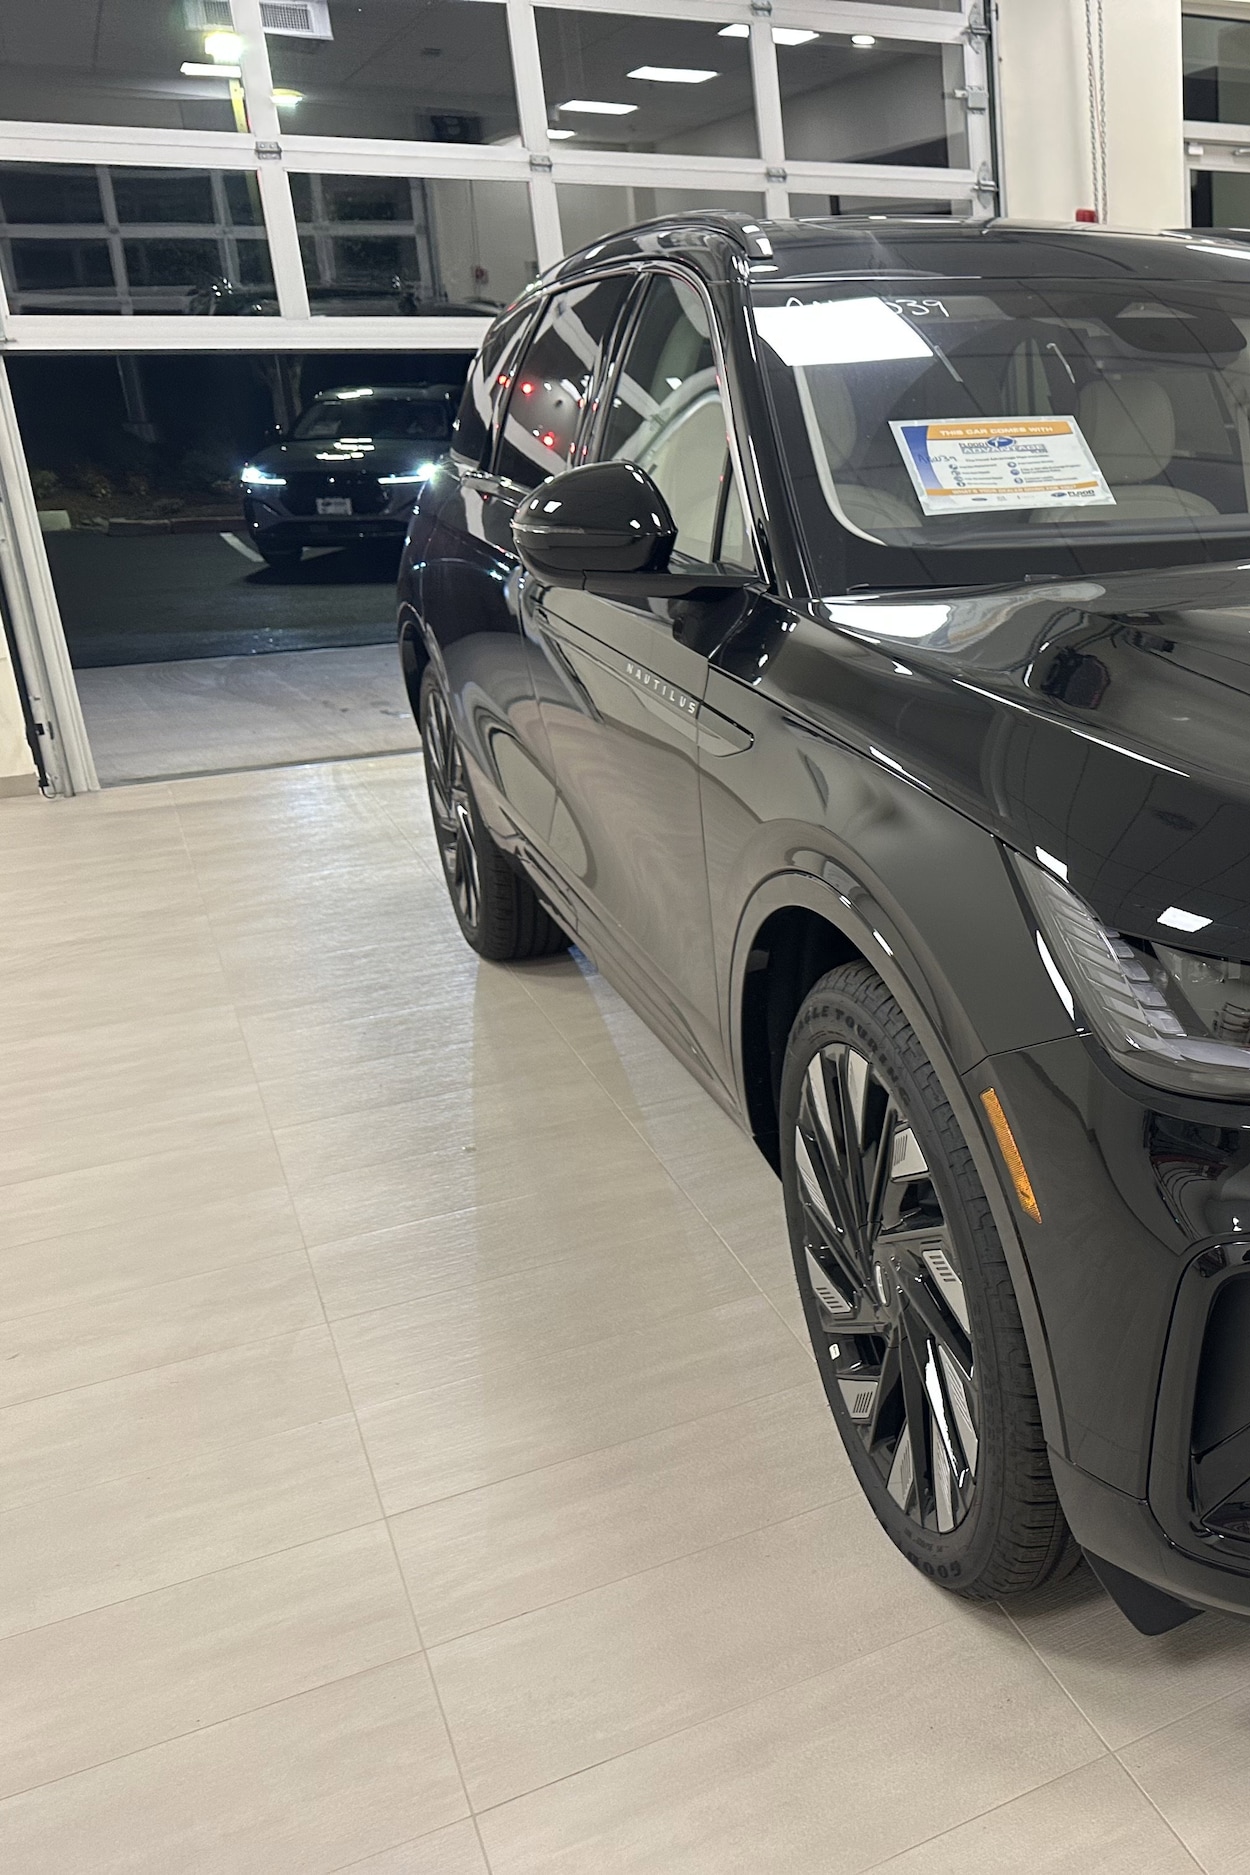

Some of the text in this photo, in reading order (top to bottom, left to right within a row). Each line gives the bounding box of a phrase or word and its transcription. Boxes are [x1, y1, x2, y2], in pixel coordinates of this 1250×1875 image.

[939, 429, 964, 437] THIS
[965, 428, 988, 436] CAR
[990, 427, 1027, 435] COMES
[626, 663, 697, 714] NAUTILUS
